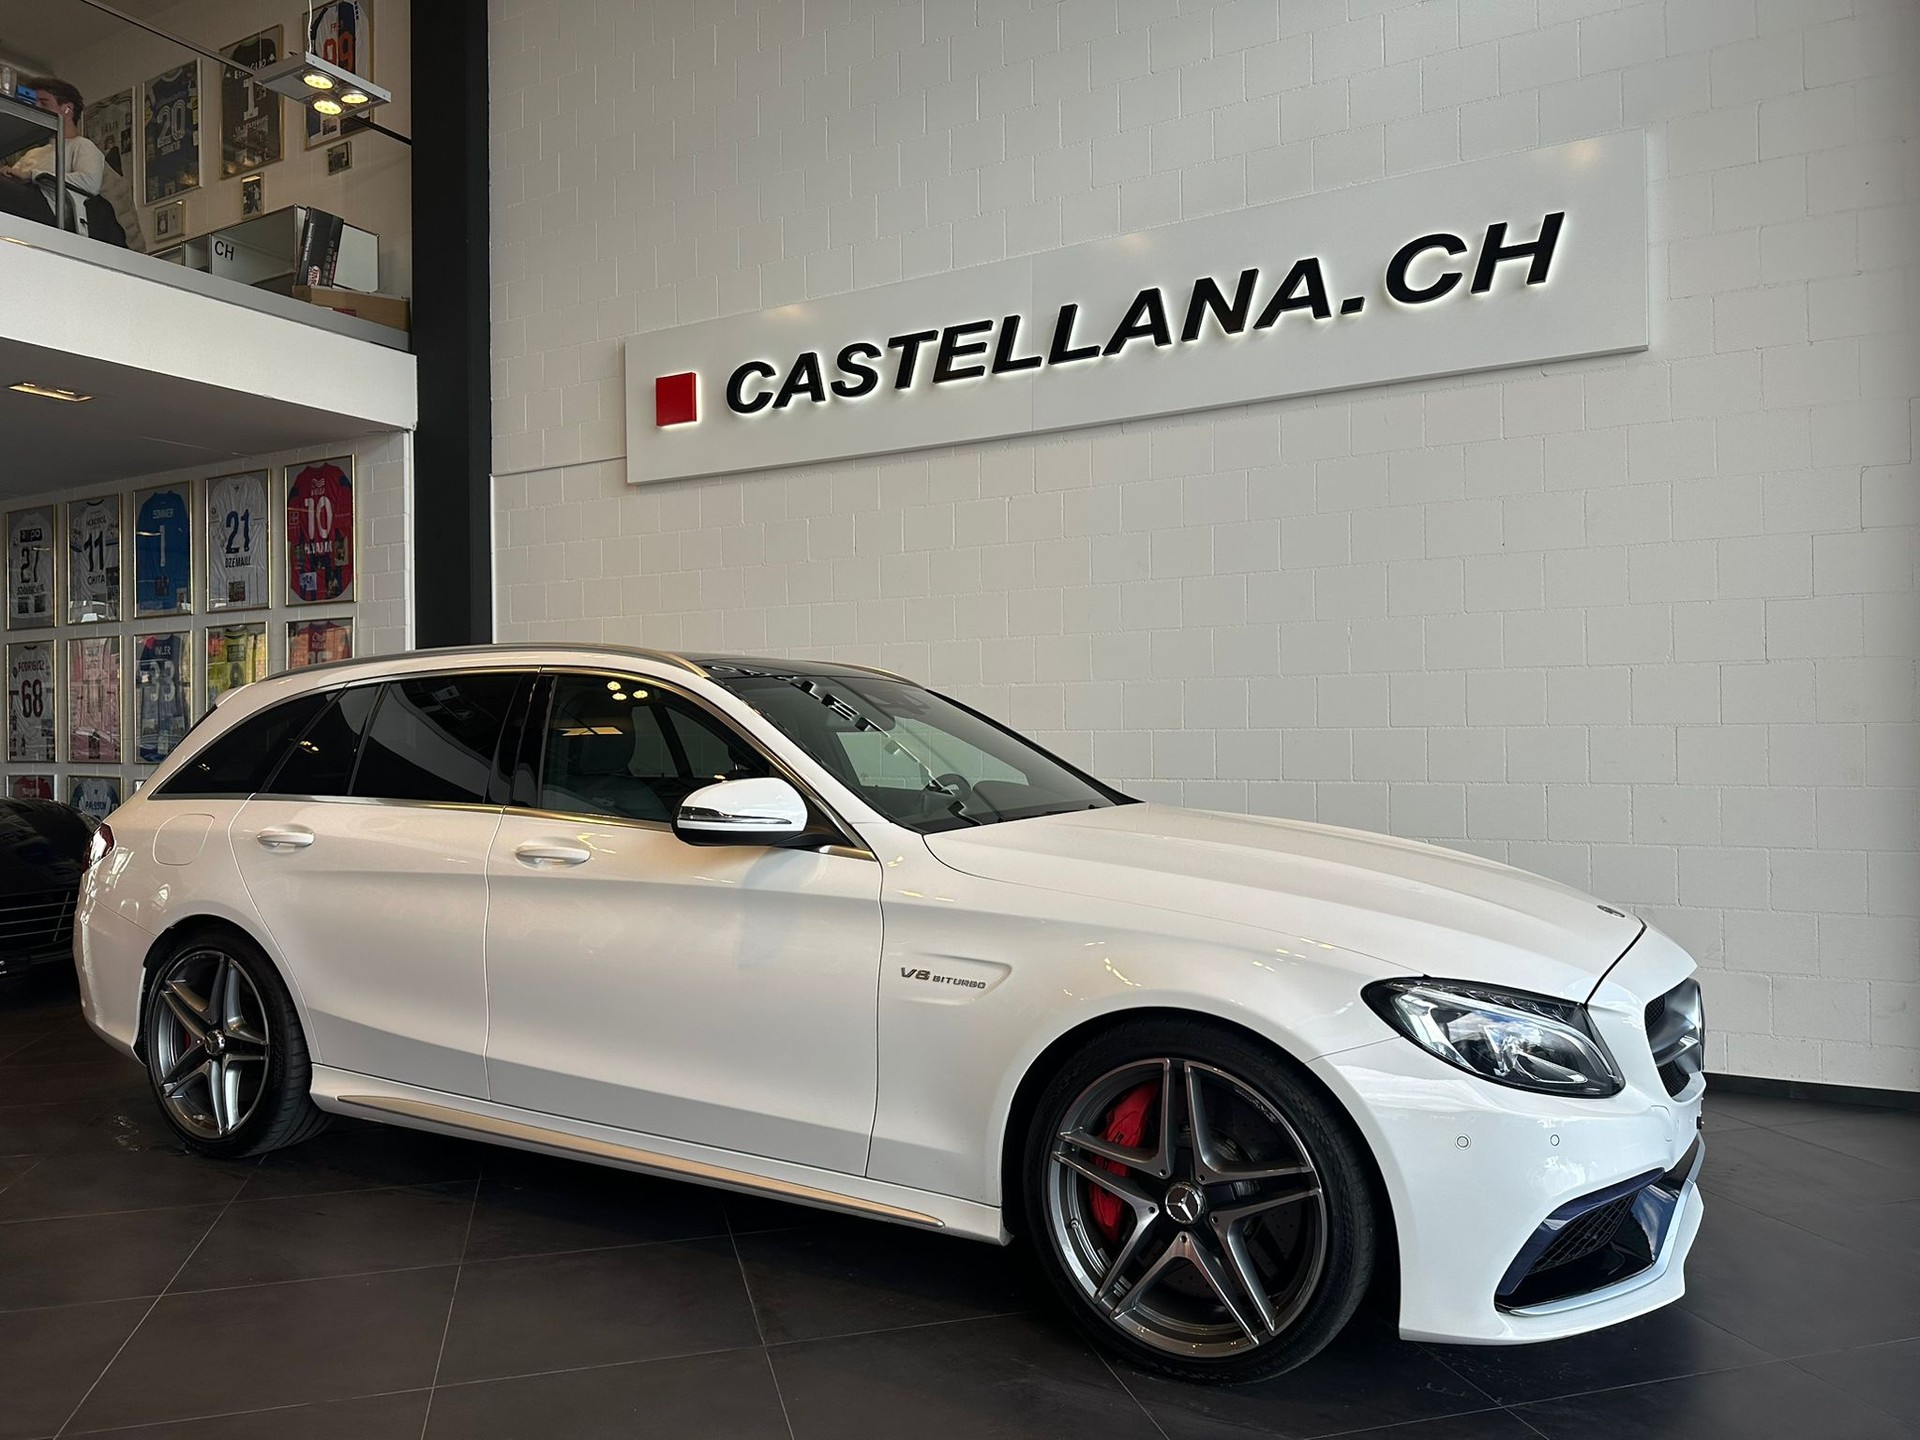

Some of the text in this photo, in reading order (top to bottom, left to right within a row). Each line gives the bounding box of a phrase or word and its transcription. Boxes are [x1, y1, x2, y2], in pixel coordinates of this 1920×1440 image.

[157, 100, 186, 149] 20
[214, 240, 235, 261] CH
[725, 211, 1566, 416] CASTELLANA.CH
[225, 508, 250, 555] 21
[304, 495, 333, 540] 10
[20, 545, 41, 583] 27
[84, 531, 105, 572] 11
[160, 524, 166, 567] 1
[21, 678, 44, 719] 68
[149, 660, 176, 702] 33
[901, 967, 986, 989] V8 BITURBO
